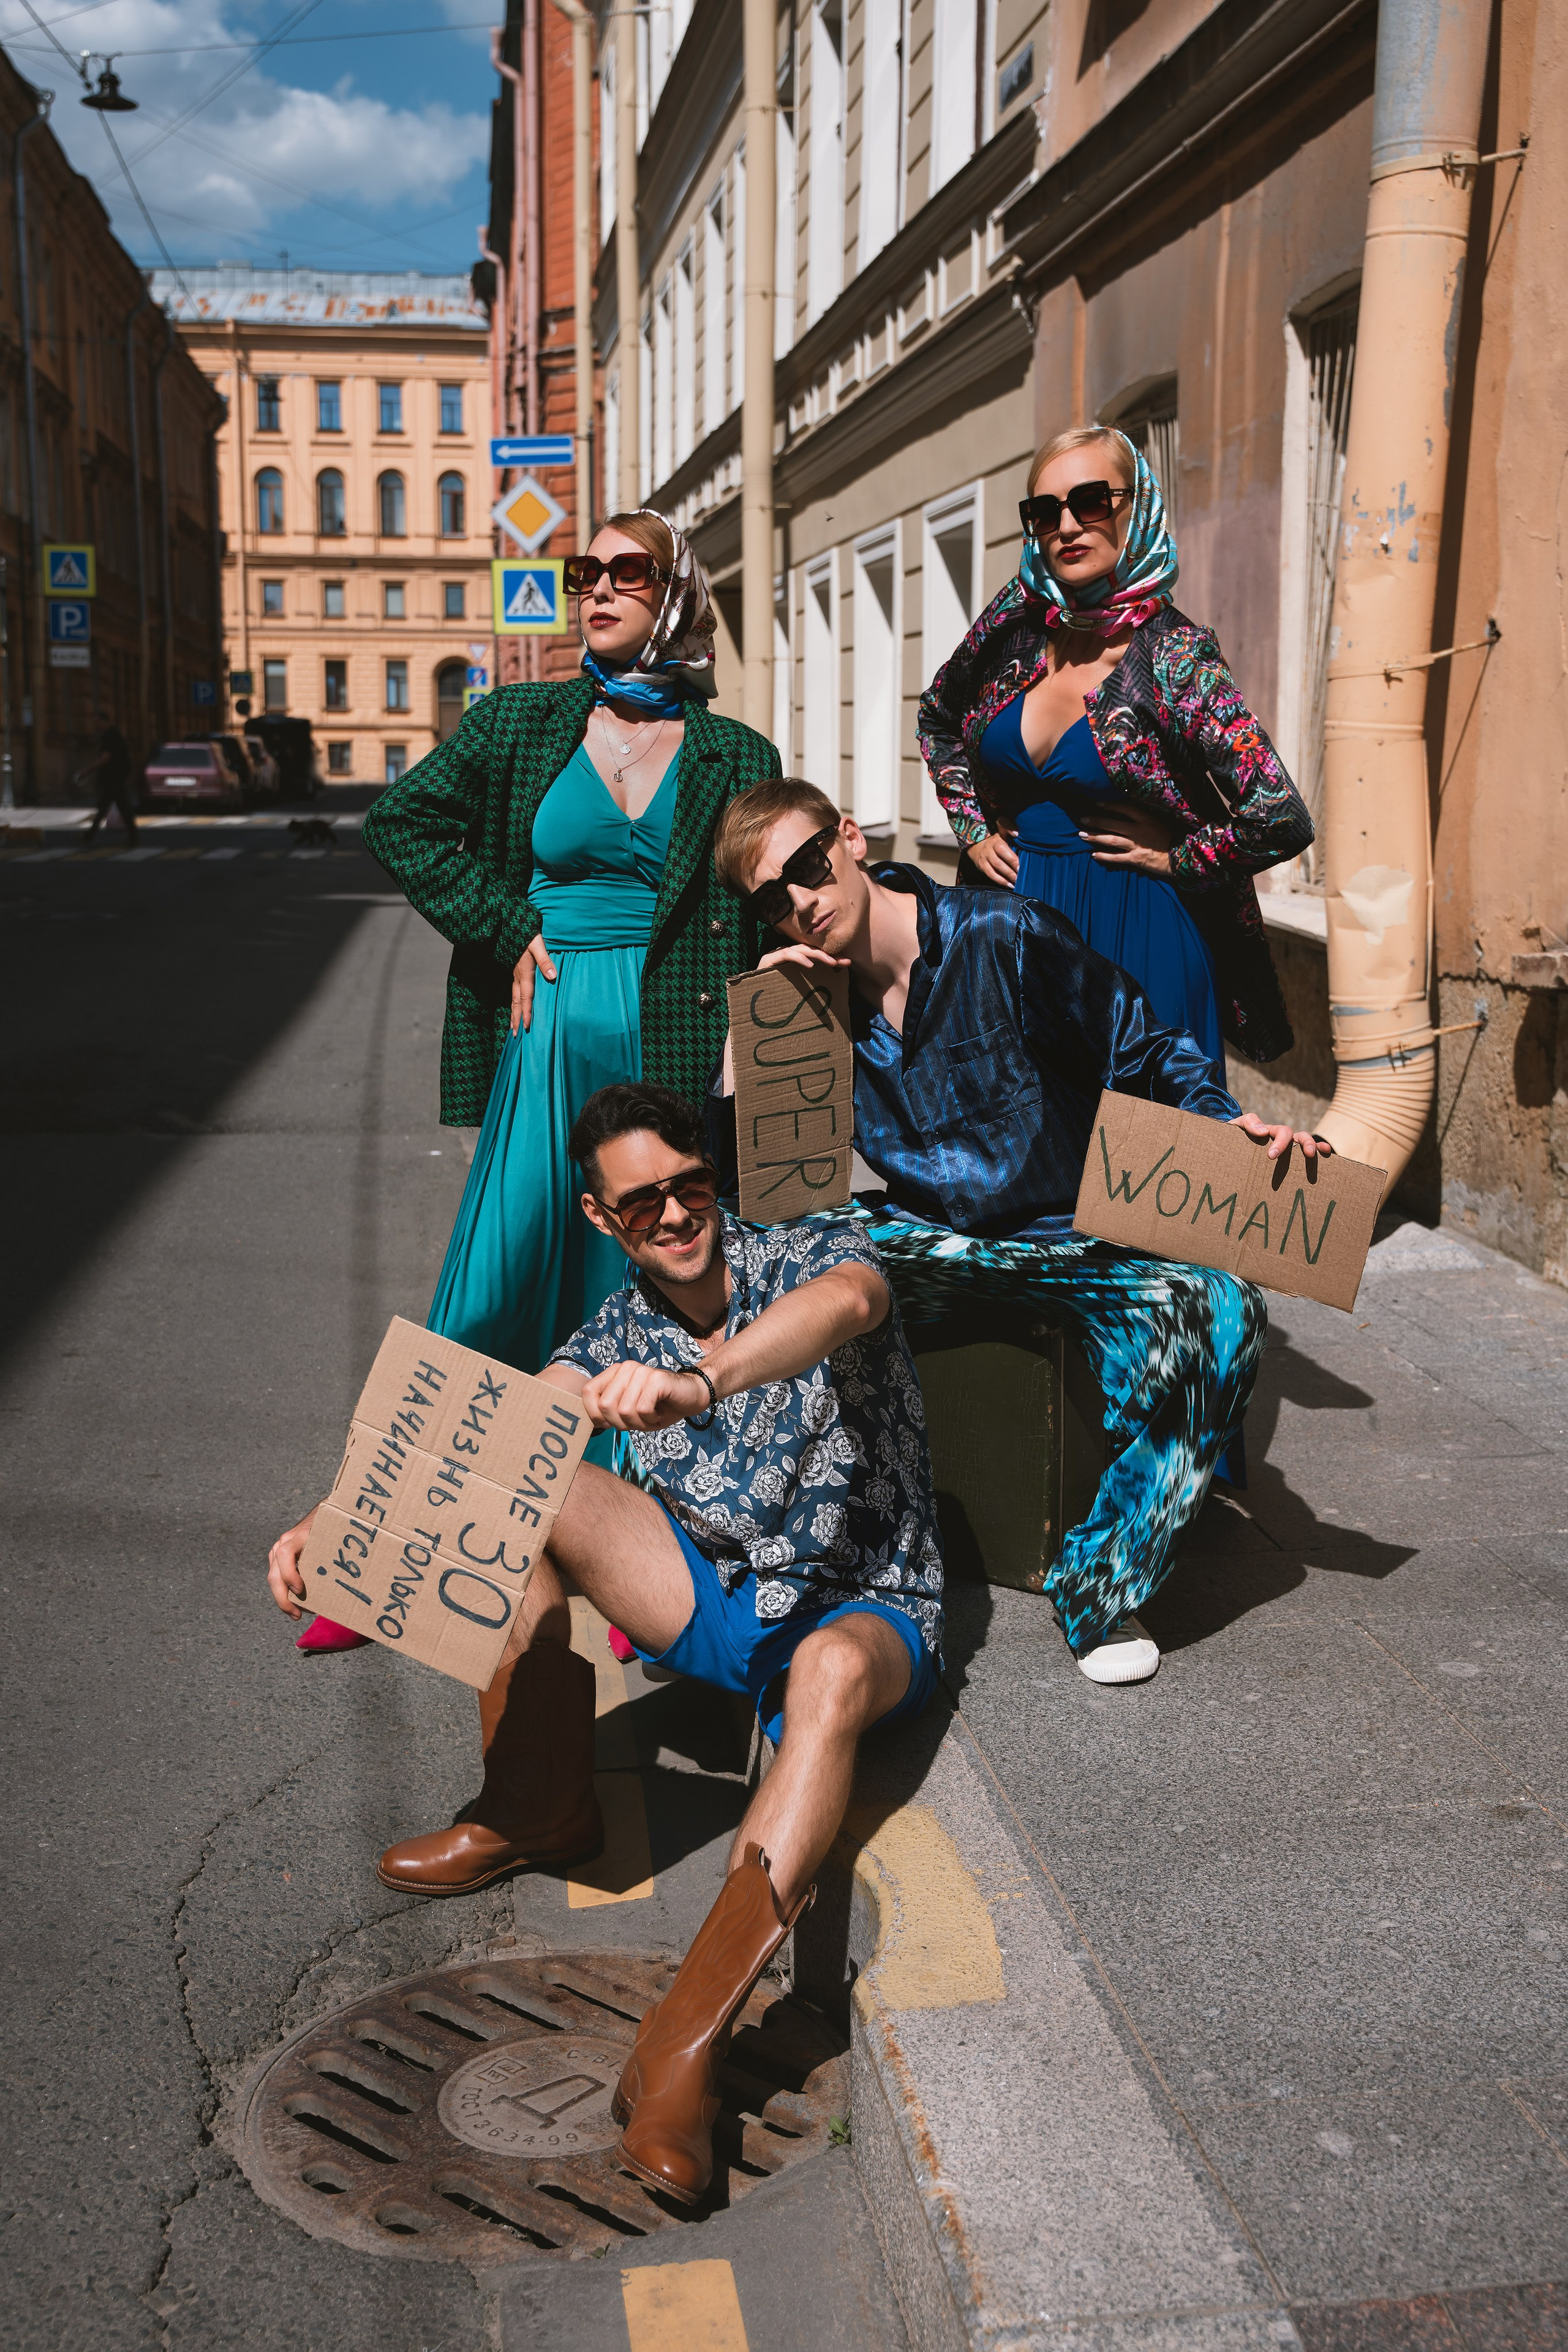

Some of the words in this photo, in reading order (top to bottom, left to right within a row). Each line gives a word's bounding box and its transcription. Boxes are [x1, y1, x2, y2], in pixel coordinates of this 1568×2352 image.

[59, 606, 83, 638] P
[750, 986, 837, 1200] SUPER
[1098, 1125, 1337, 1265] WOMAN
[316, 1359, 448, 1607] НАЧИНАЕТСЯ!
[428, 1368, 507, 1507] ЖИЗНЬ
[508, 1403, 581, 1528] ПОСЛЕ
[375, 1527, 442, 1640] ТОЛЬКО
[437, 1521, 530, 1630] 30
